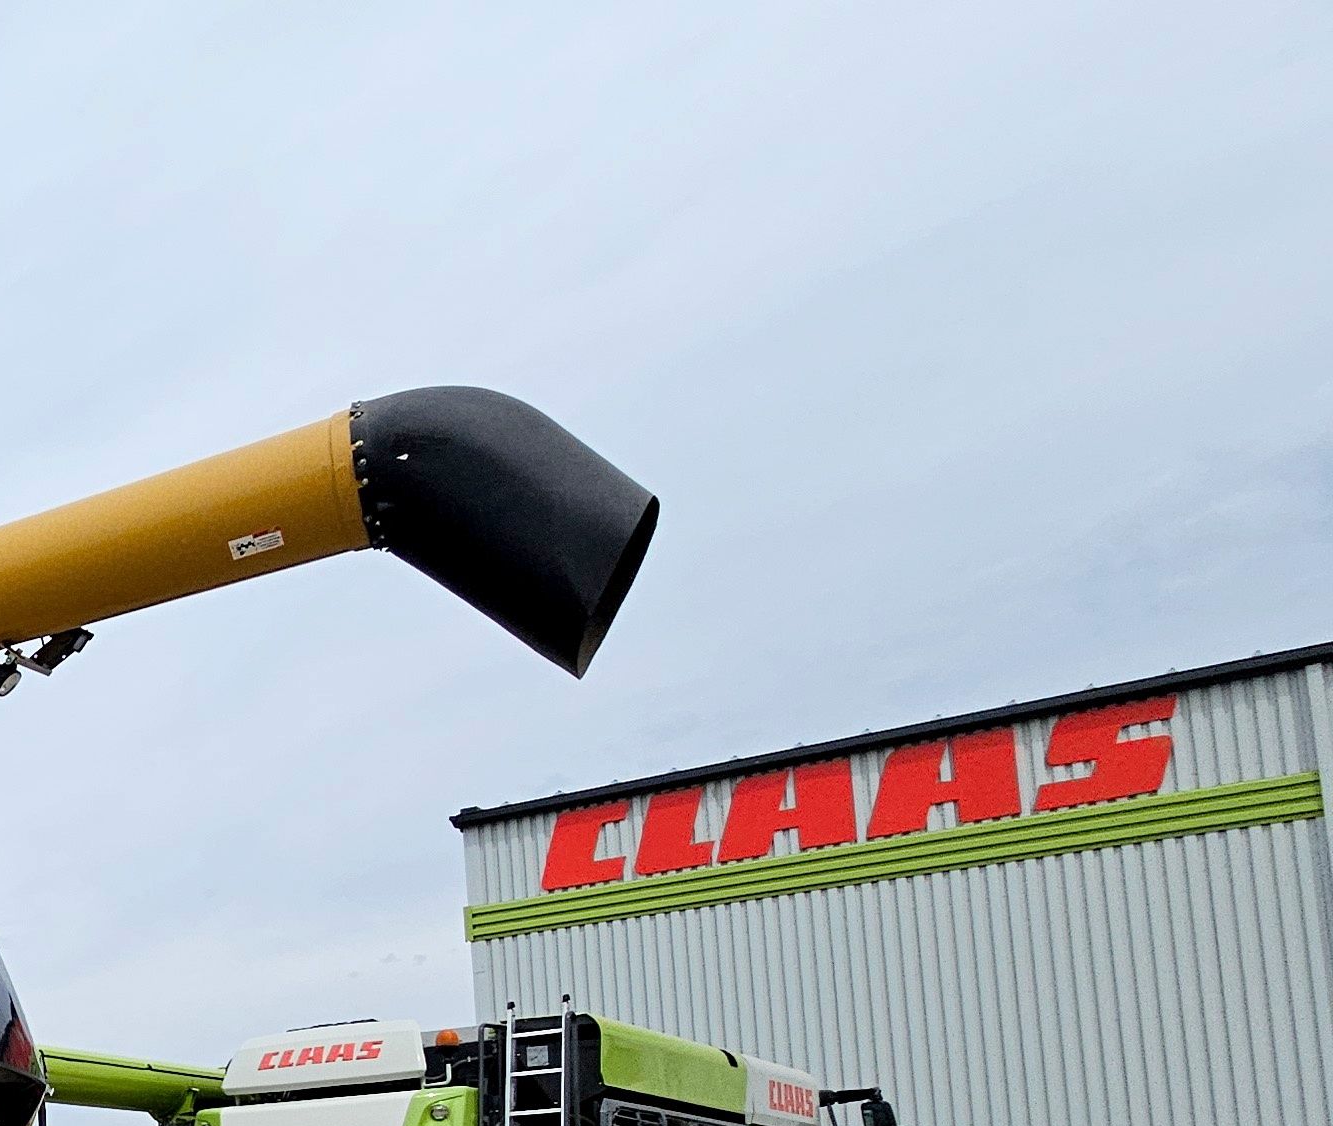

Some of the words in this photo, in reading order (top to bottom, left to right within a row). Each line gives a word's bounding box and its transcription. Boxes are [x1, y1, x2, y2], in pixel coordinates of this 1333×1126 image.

[541, 696, 1177, 890] CLAAS
[258, 1040, 384, 1071] CLAAS
[768, 1079, 814, 1118] CLAAS
